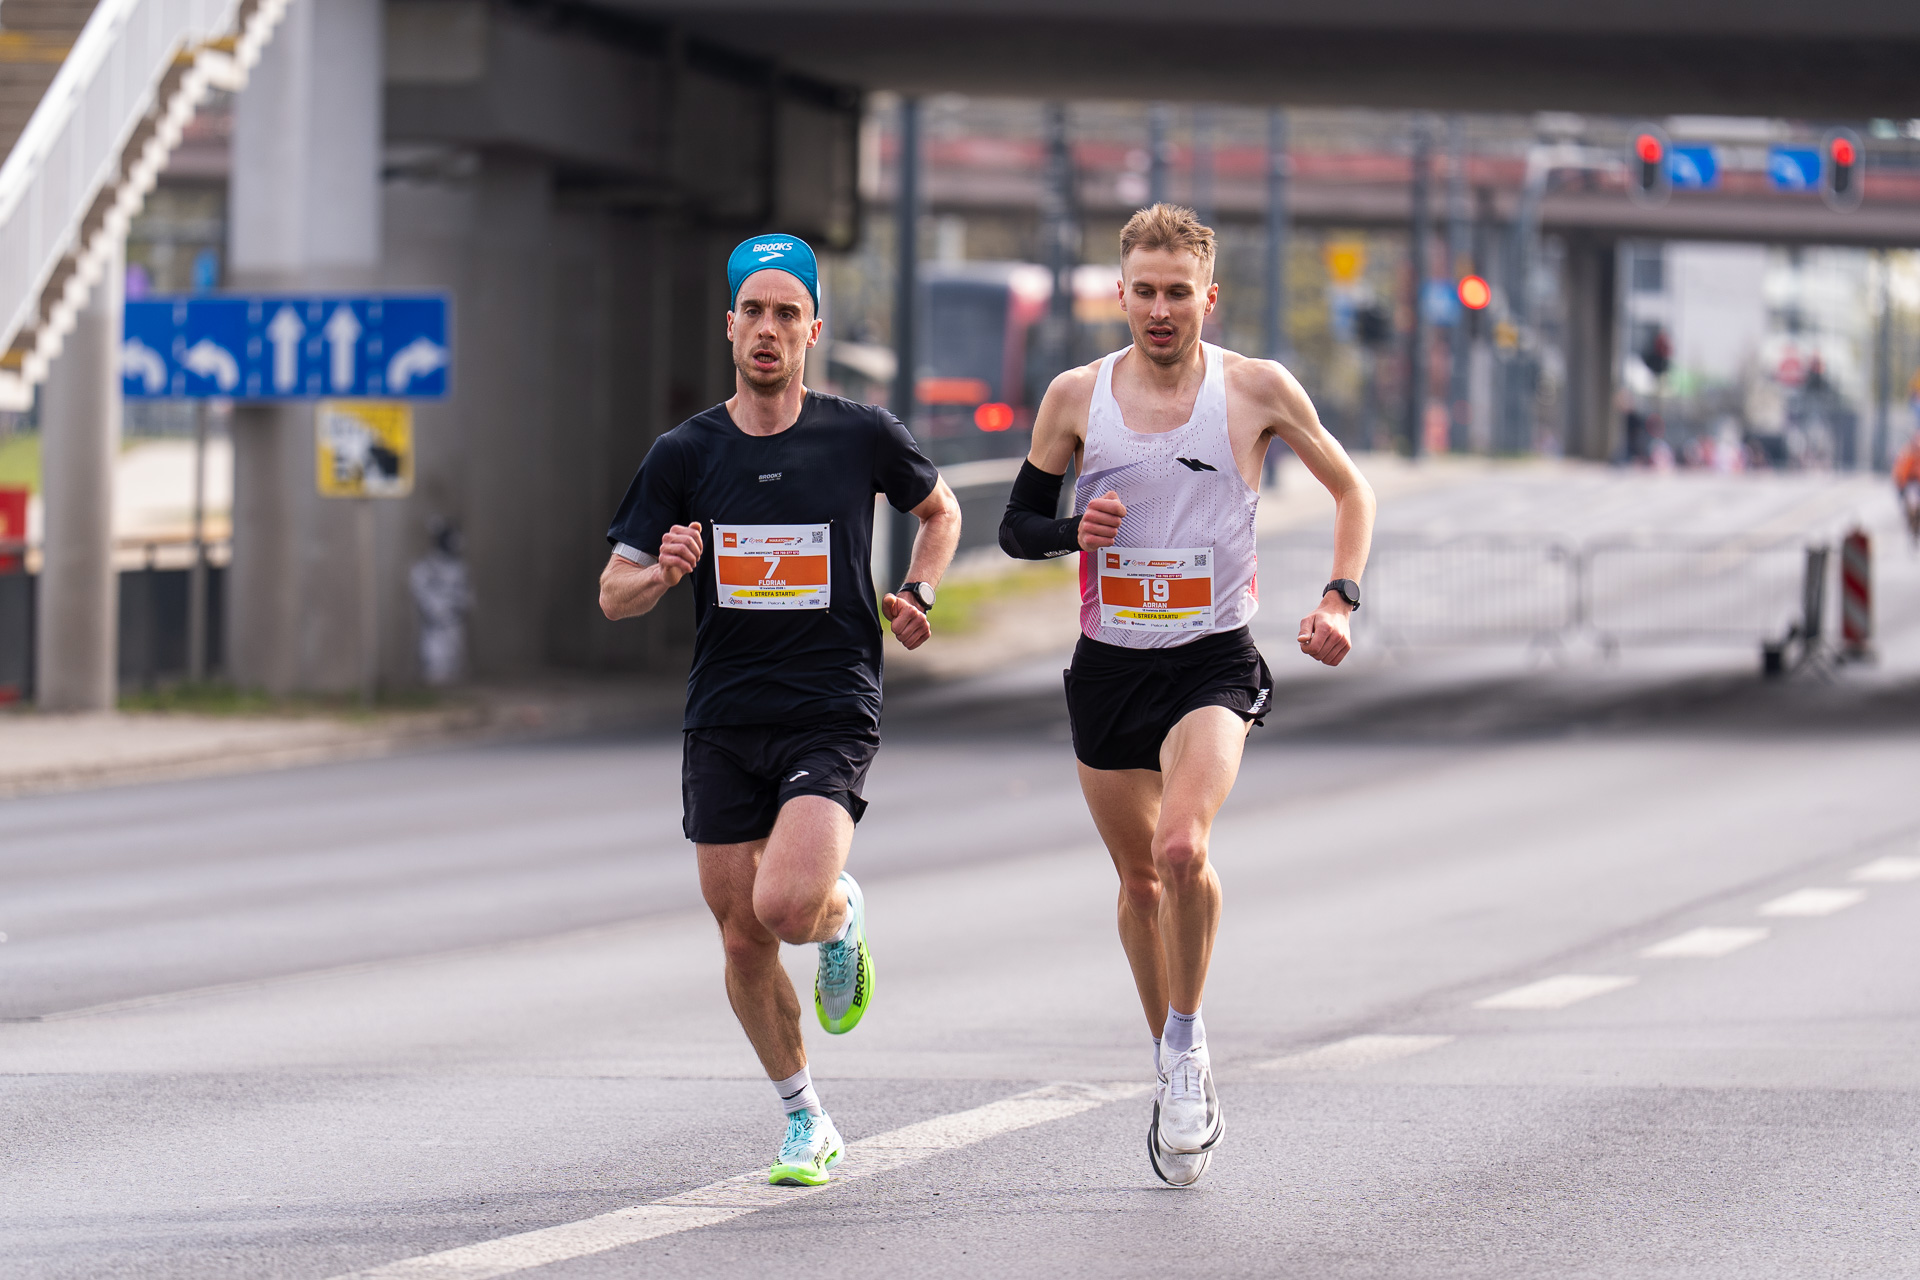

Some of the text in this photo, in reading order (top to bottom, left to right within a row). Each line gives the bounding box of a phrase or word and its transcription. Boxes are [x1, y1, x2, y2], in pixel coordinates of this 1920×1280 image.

[752, 243, 793, 252] BROOKS
[758, 472, 782, 480] BROOKS
[763, 556, 781, 579] 7
[1139, 579, 1170, 602] 19
[1142, 601, 1168, 609] ADRIAN
